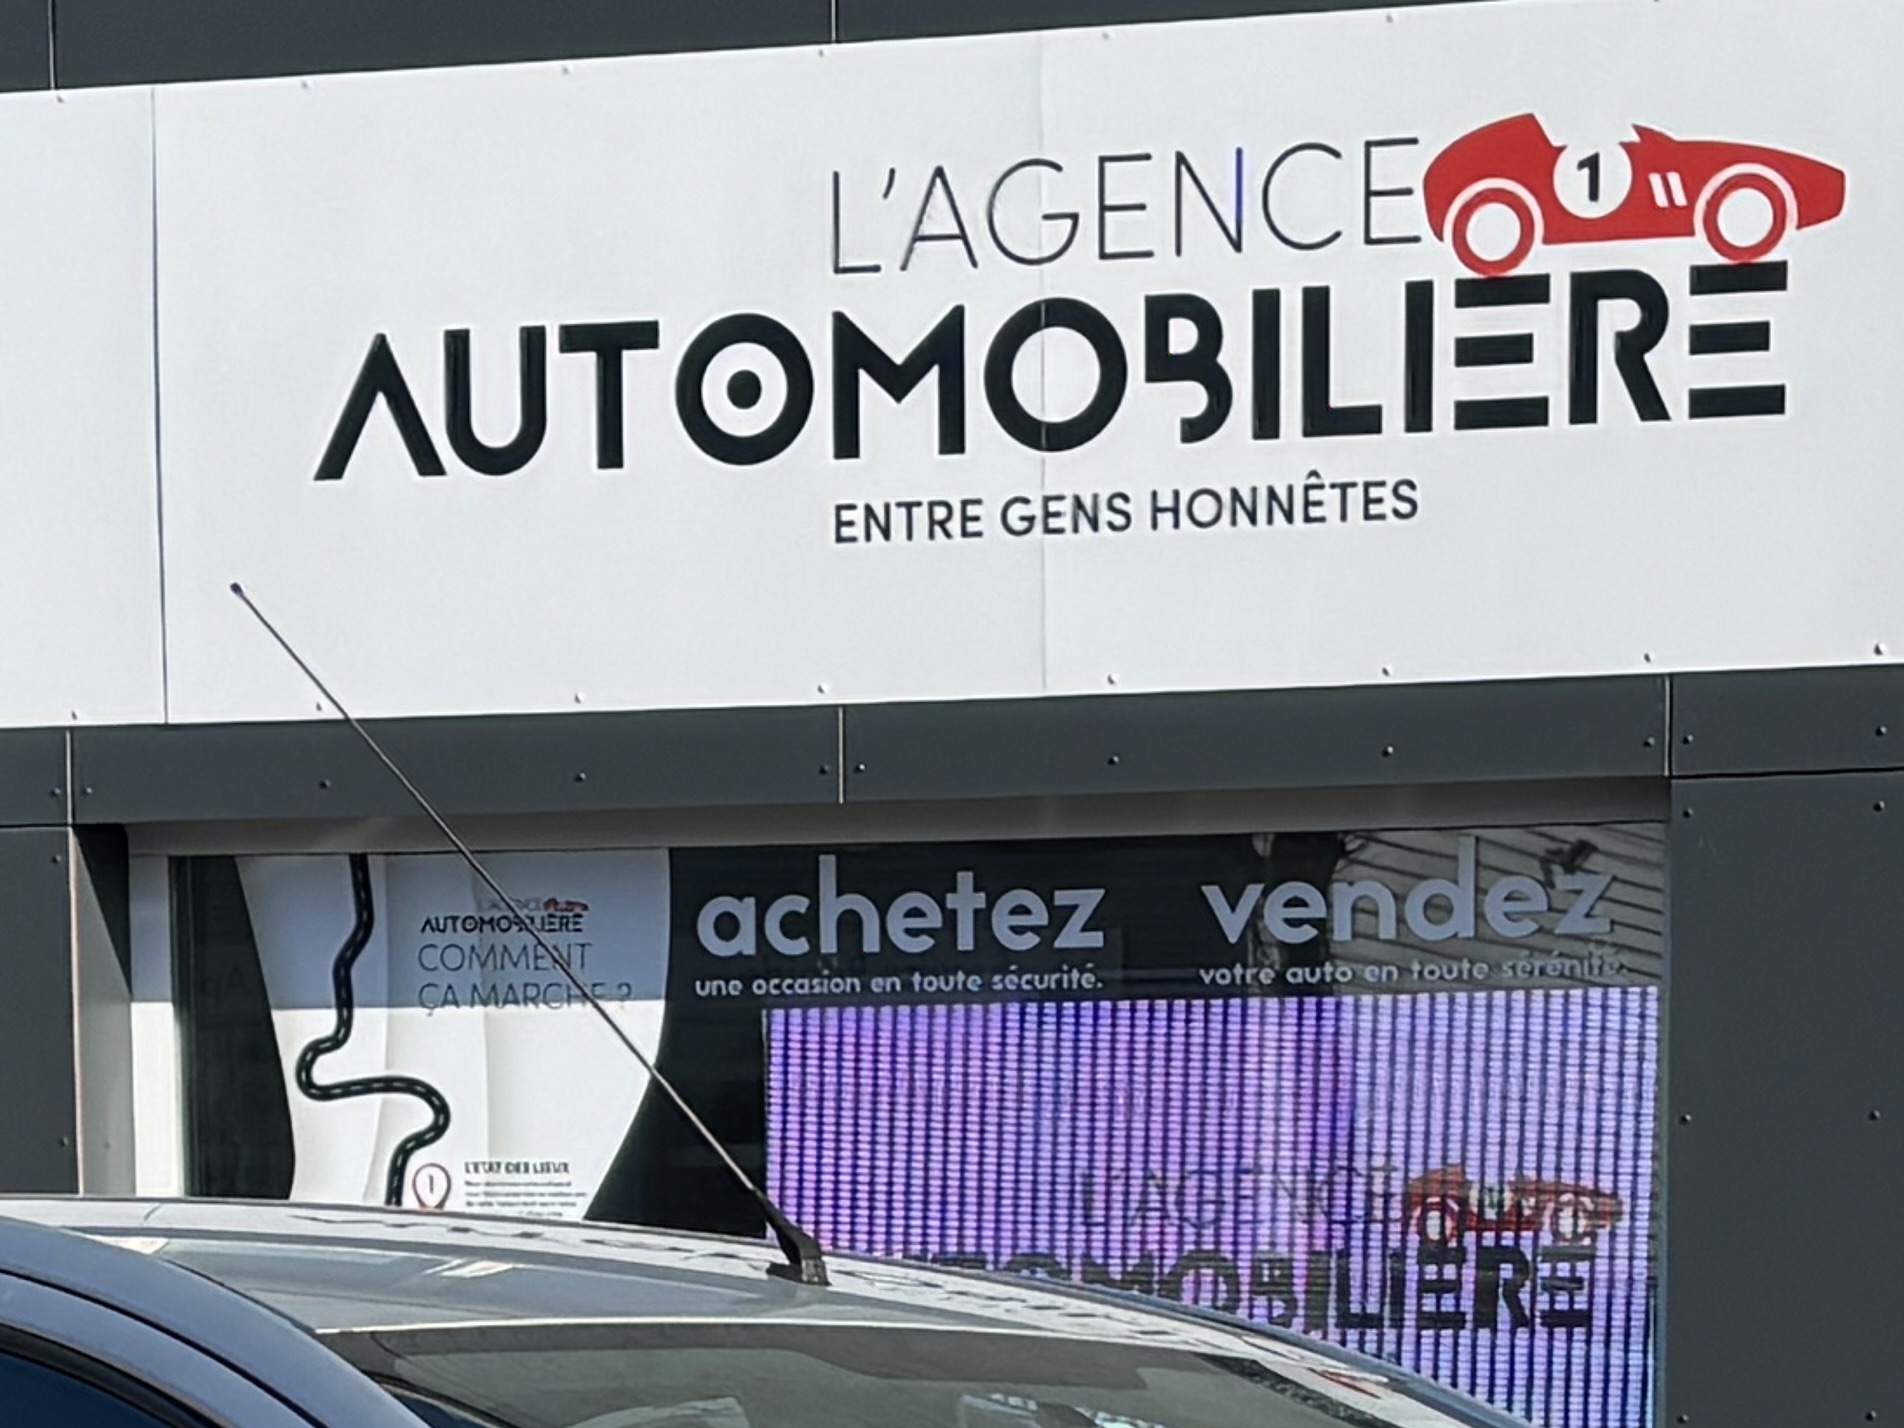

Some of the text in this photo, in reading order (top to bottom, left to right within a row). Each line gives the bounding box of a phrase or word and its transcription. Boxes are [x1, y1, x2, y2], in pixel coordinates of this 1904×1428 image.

[832, 137, 1423, 275] L'AGENCE
[833, 469, 1419, 545] ENTRE GENS HONNÊTES
[695, 834, 1619, 958] achetez vendez
[417, 942, 594, 972] COMMENT
[1199, 962, 1276, 987] votre
[1284, 959, 1354, 986] auto
[1364, 962, 1399, 983] en
[1410, 957, 1490, 982] toute
[695, 961, 1104, 997] une occasion en toute sécurité.
[417, 982, 460, 1017] ÇA
[470, 982, 607, 1010] MARCHE
